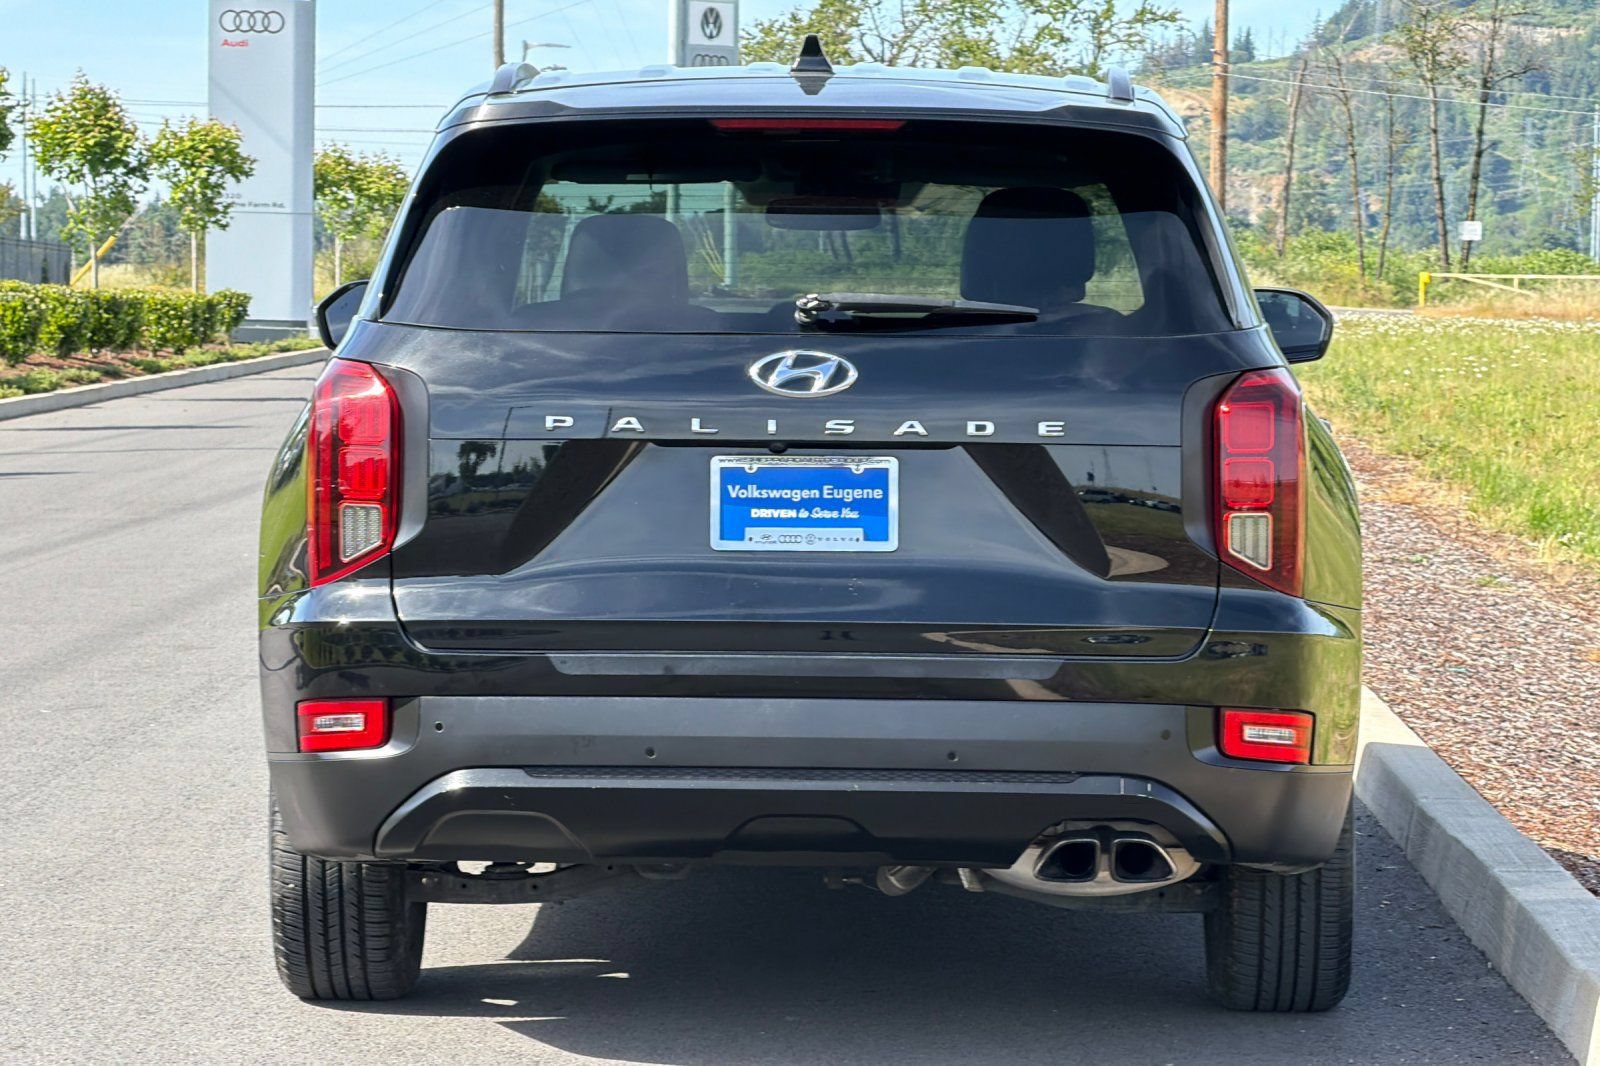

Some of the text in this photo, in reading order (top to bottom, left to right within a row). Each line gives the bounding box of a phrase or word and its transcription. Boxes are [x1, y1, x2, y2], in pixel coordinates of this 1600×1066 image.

[221, 38, 249, 48] Audi
[545, 415, 1066, 437] PALISADE
[727, 484, 884, 501] Volkswagen Eugene
[751, 508, 798, 518] DRIVEN
[798, 508, 810, 518] to
